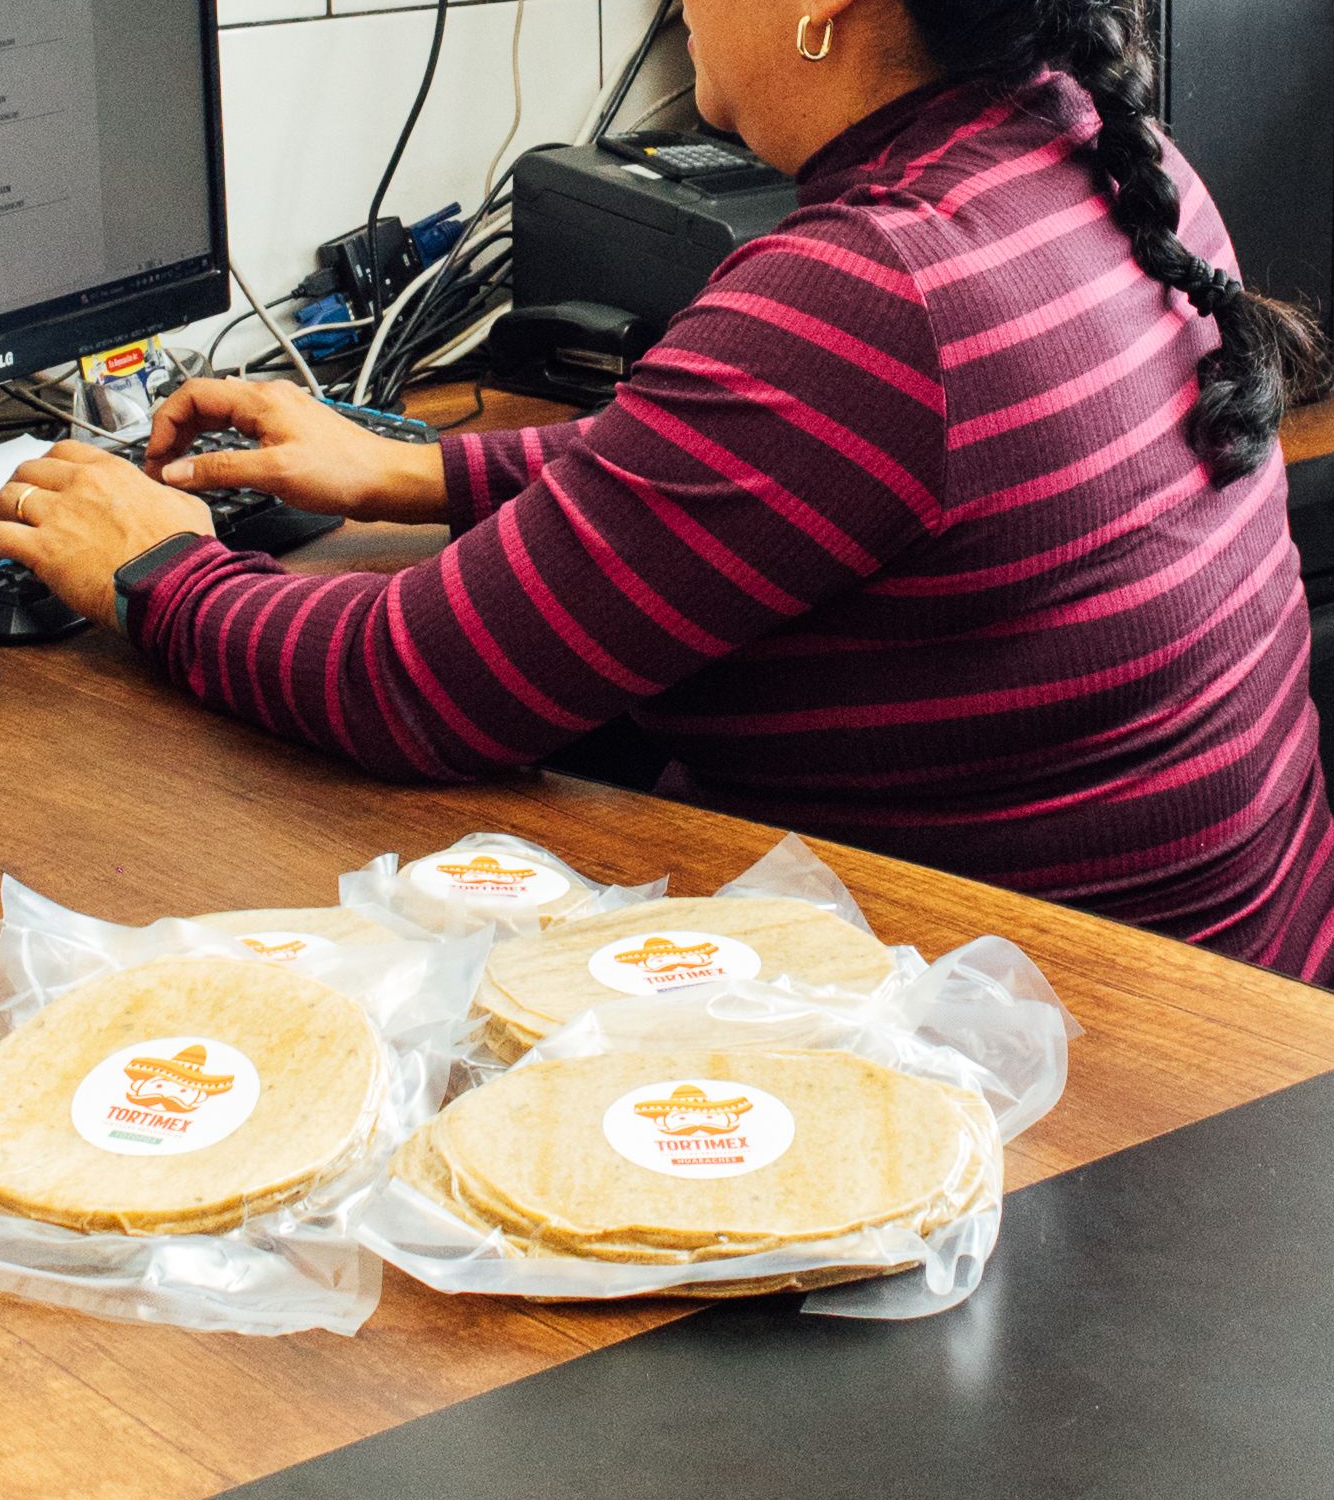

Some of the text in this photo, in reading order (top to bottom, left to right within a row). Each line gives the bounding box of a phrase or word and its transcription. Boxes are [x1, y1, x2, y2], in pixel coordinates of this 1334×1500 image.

[644, 967, 727, 985] TORTIMEX
[106, 1105, 193, 1133] TORTIMEX
[654, 1137, 750, 1152] TORTIMEX
[677, 1156, 738, 1165] HUARACHES
